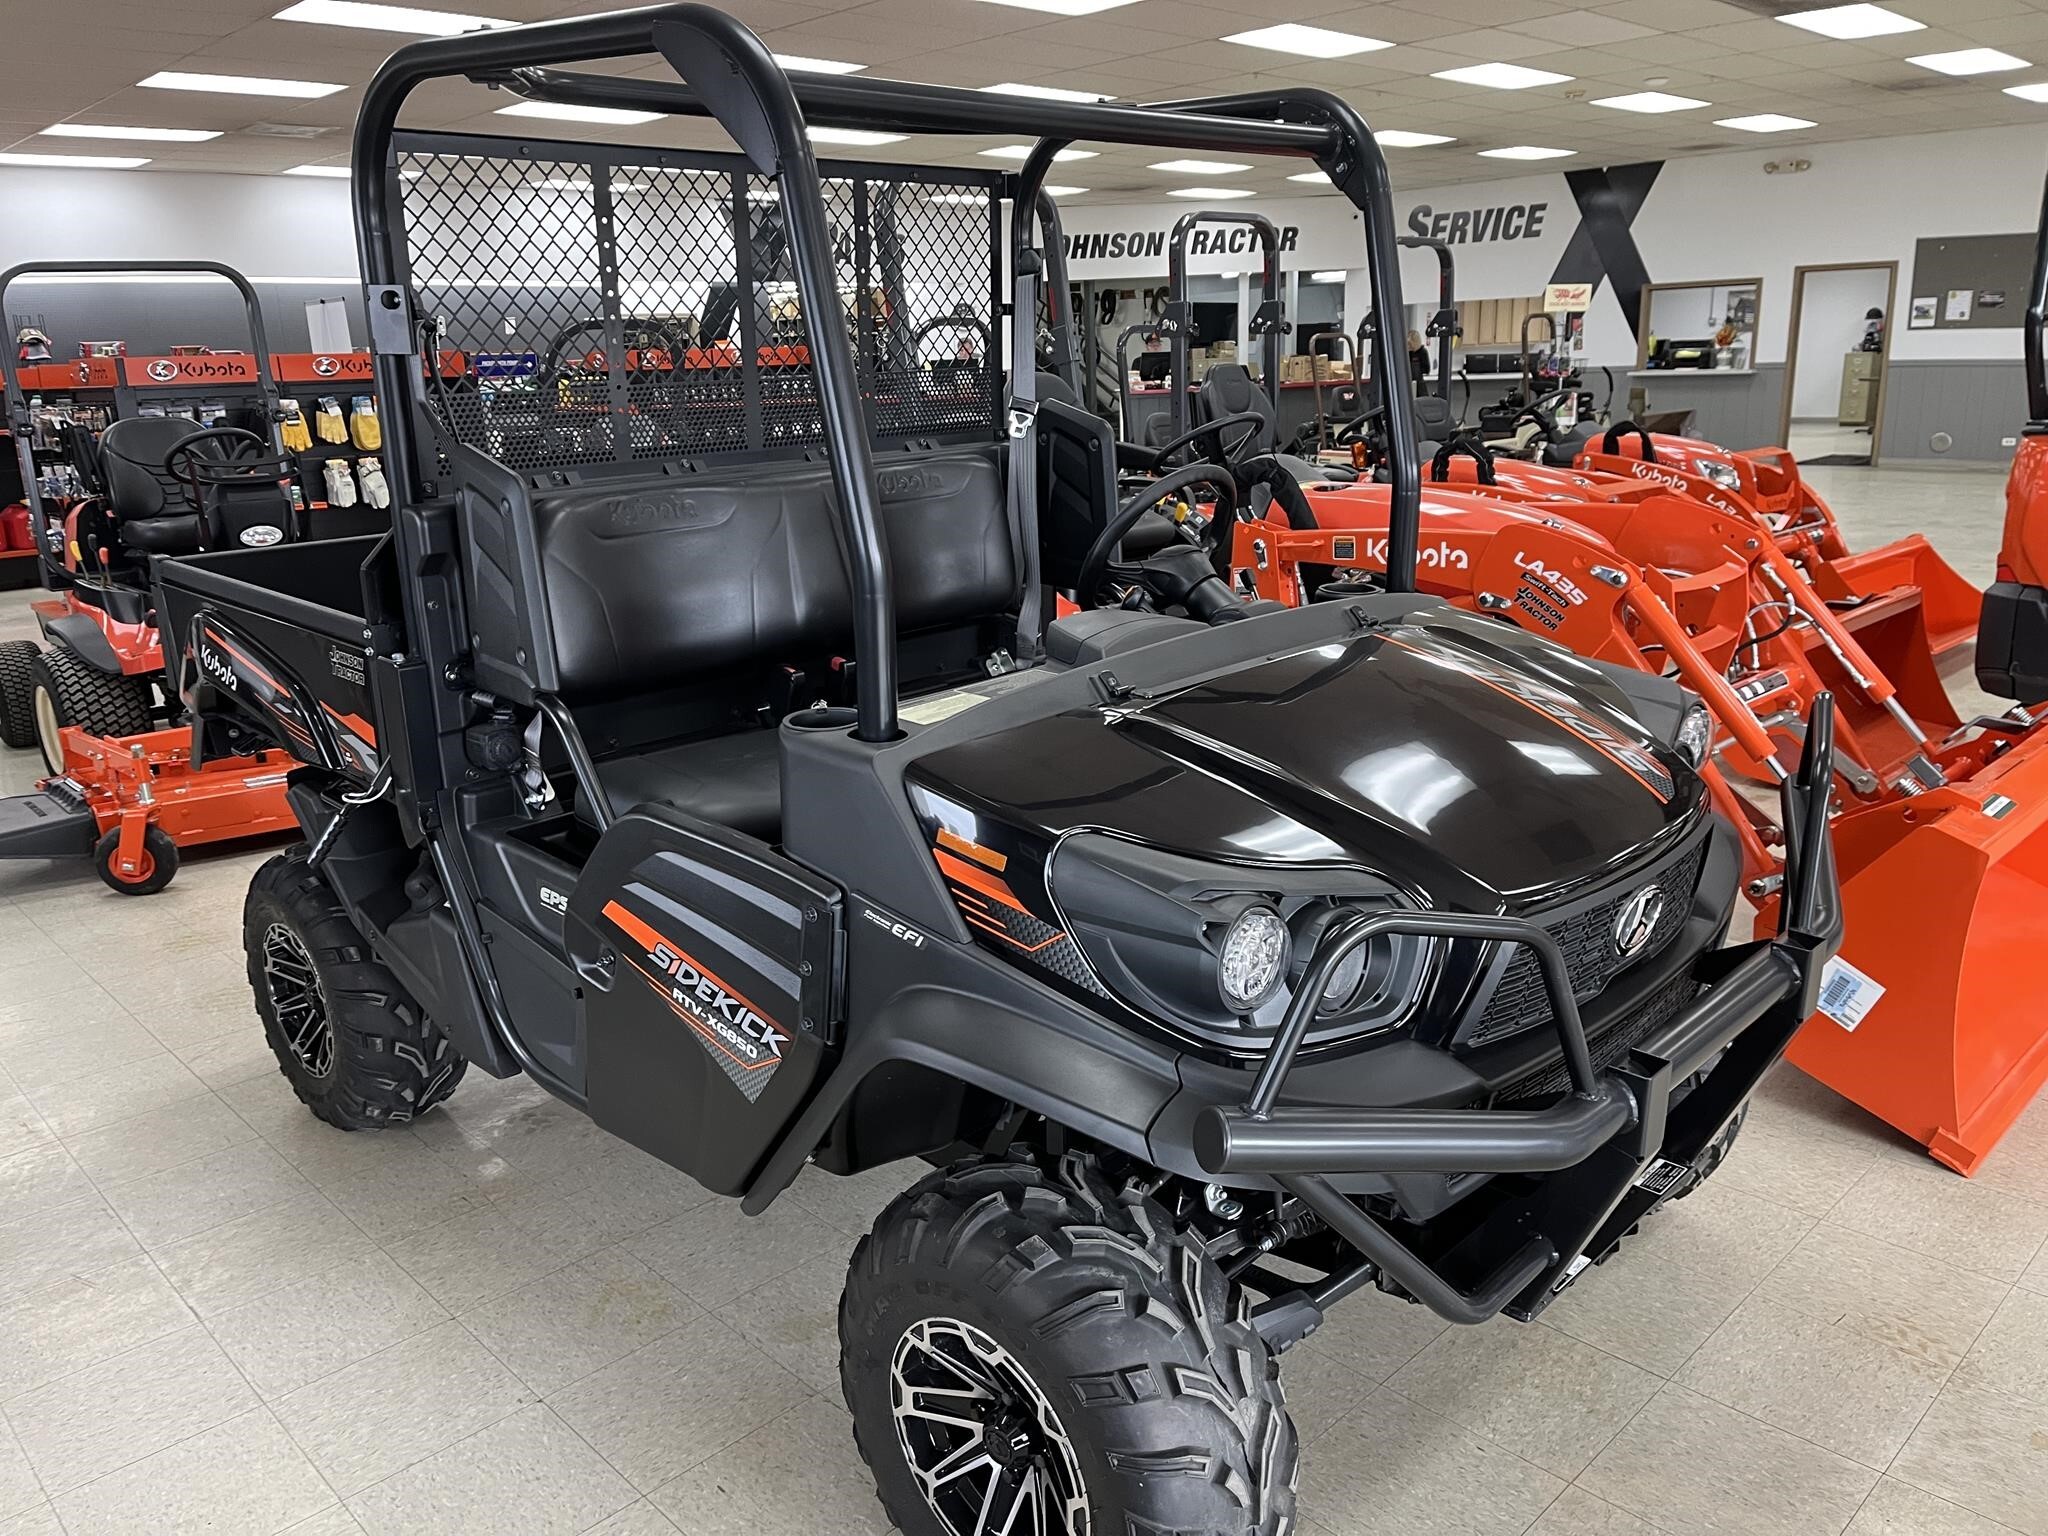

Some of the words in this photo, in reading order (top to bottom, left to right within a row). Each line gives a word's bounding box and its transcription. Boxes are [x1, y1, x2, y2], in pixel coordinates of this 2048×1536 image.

[1408, 203, 1548, 244] SERVICE
[1062, 231, 1165, 260] HNSON
[1190, 226, 1299, 255] RACTR
[179, 361, 246, 377] Kubota
[340, 359, 373, 373] Kub
[1631, 462, 1688, 492] Kubota
[1366, 537, 1468, 569] Kota
[1513, 551, 1589, 606] LA435
[1513, 593, 1558, 632] TRACTOR
[1518, 586, 1565, 623] JOHNSON
[201, 644, 238, 691] Kubota
[329, 645, 364, 671] JOHNSON
[540, 886, 569, 912] EPS
[891, 923, 925, 947] EFI
[647, 942, 790, 1059] SIDEKICK
[672, 987, 758, 1059] RTV-XG850
